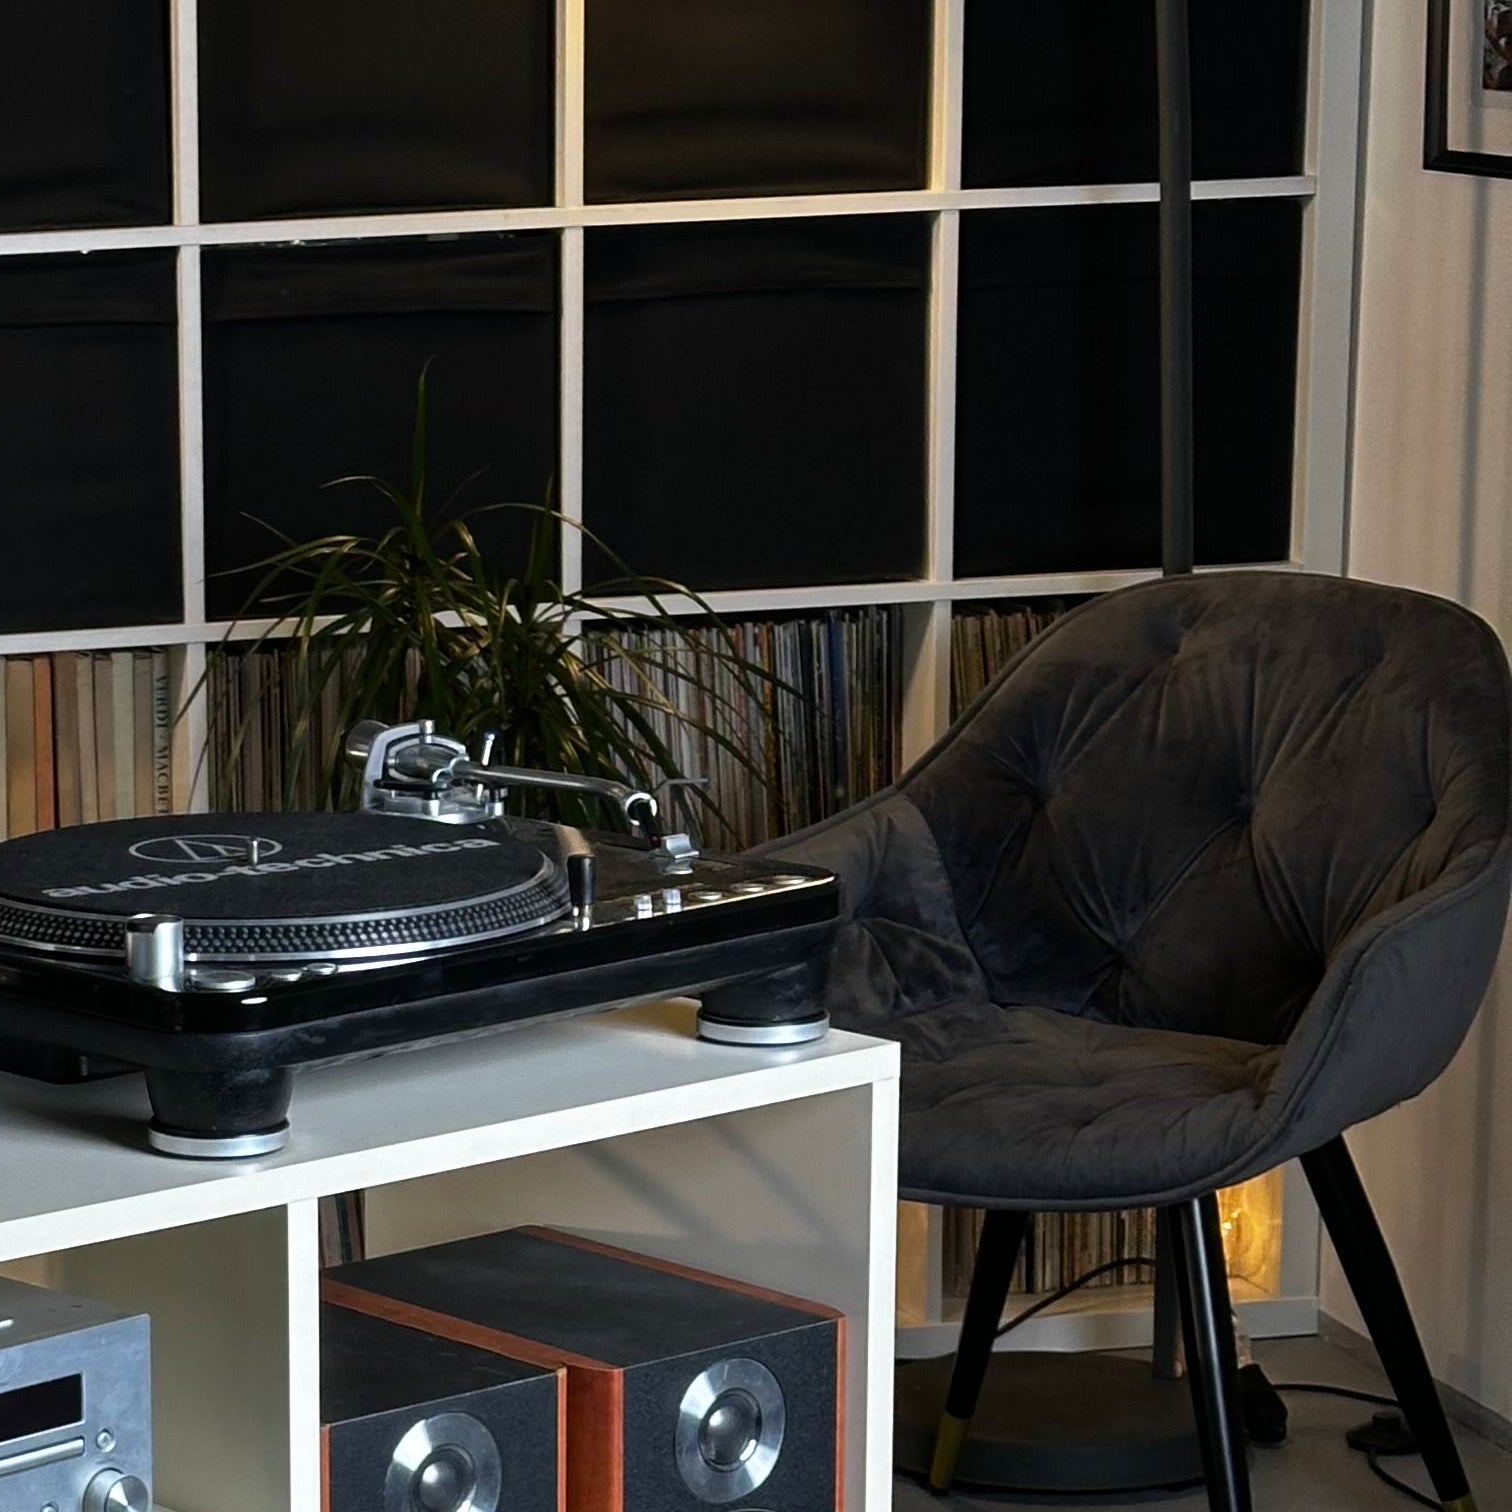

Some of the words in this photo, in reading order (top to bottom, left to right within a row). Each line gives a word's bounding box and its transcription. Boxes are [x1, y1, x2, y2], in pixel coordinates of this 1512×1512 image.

[155, 675, 169, 729] VERDI
[155, 744, 169, 815] MACBET
[41, 836, 501, 899] audio-technica
